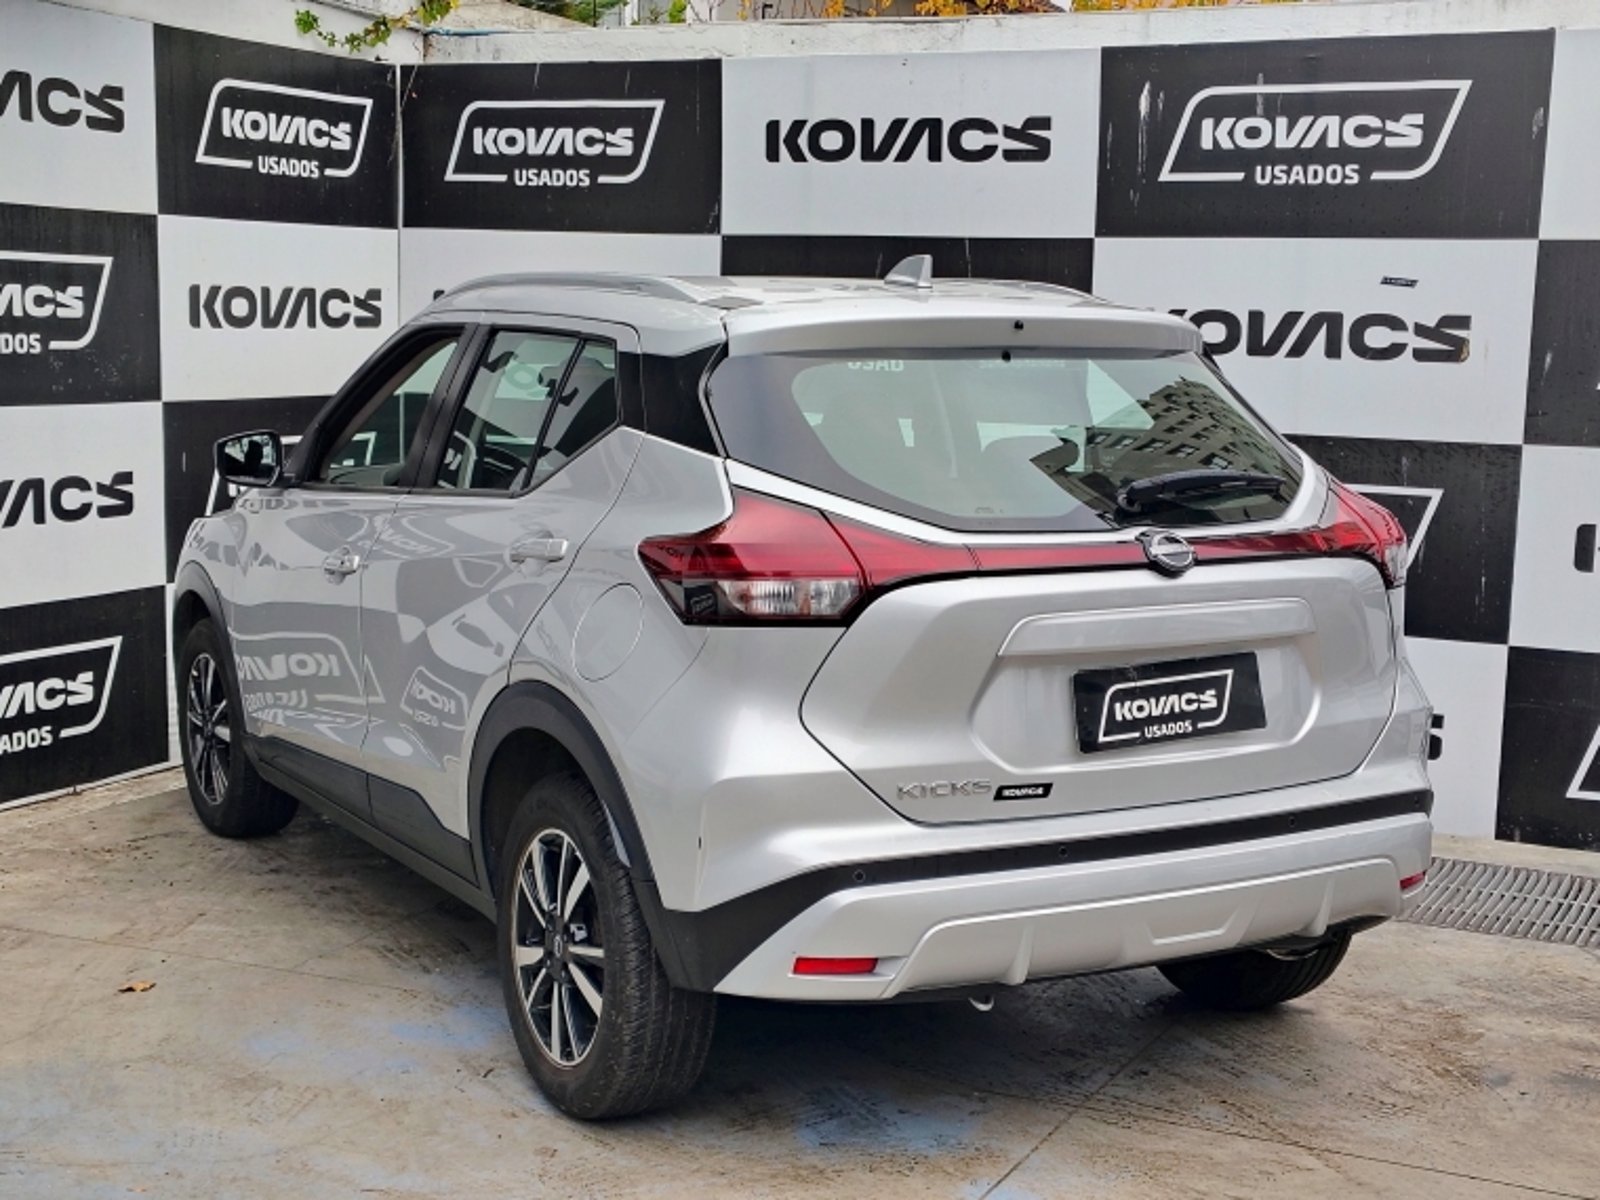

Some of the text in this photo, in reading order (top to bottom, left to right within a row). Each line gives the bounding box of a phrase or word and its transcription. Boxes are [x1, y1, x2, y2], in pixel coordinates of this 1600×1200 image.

[222, 106, 352, 151] KOVACS
[472, 126, 634, 157] KOVACS
[765, 116, 1052, 163] KOVACS
[1201, 113, 1424, 150] KOVACS
[258, 155, 319, 179] USADOS
[513, 168, 591, 187] USADOS
[1255, 164, 1360, 186] USADOS
[189, 283, 383, 329] KOVACS
[1168, 309, 1472, 363] OVACS
[1115, 688, 1218, 722] KOVACS
[1144, 720, 1193, 739] USADOS
[897, 779, 992, 801] KICKS
